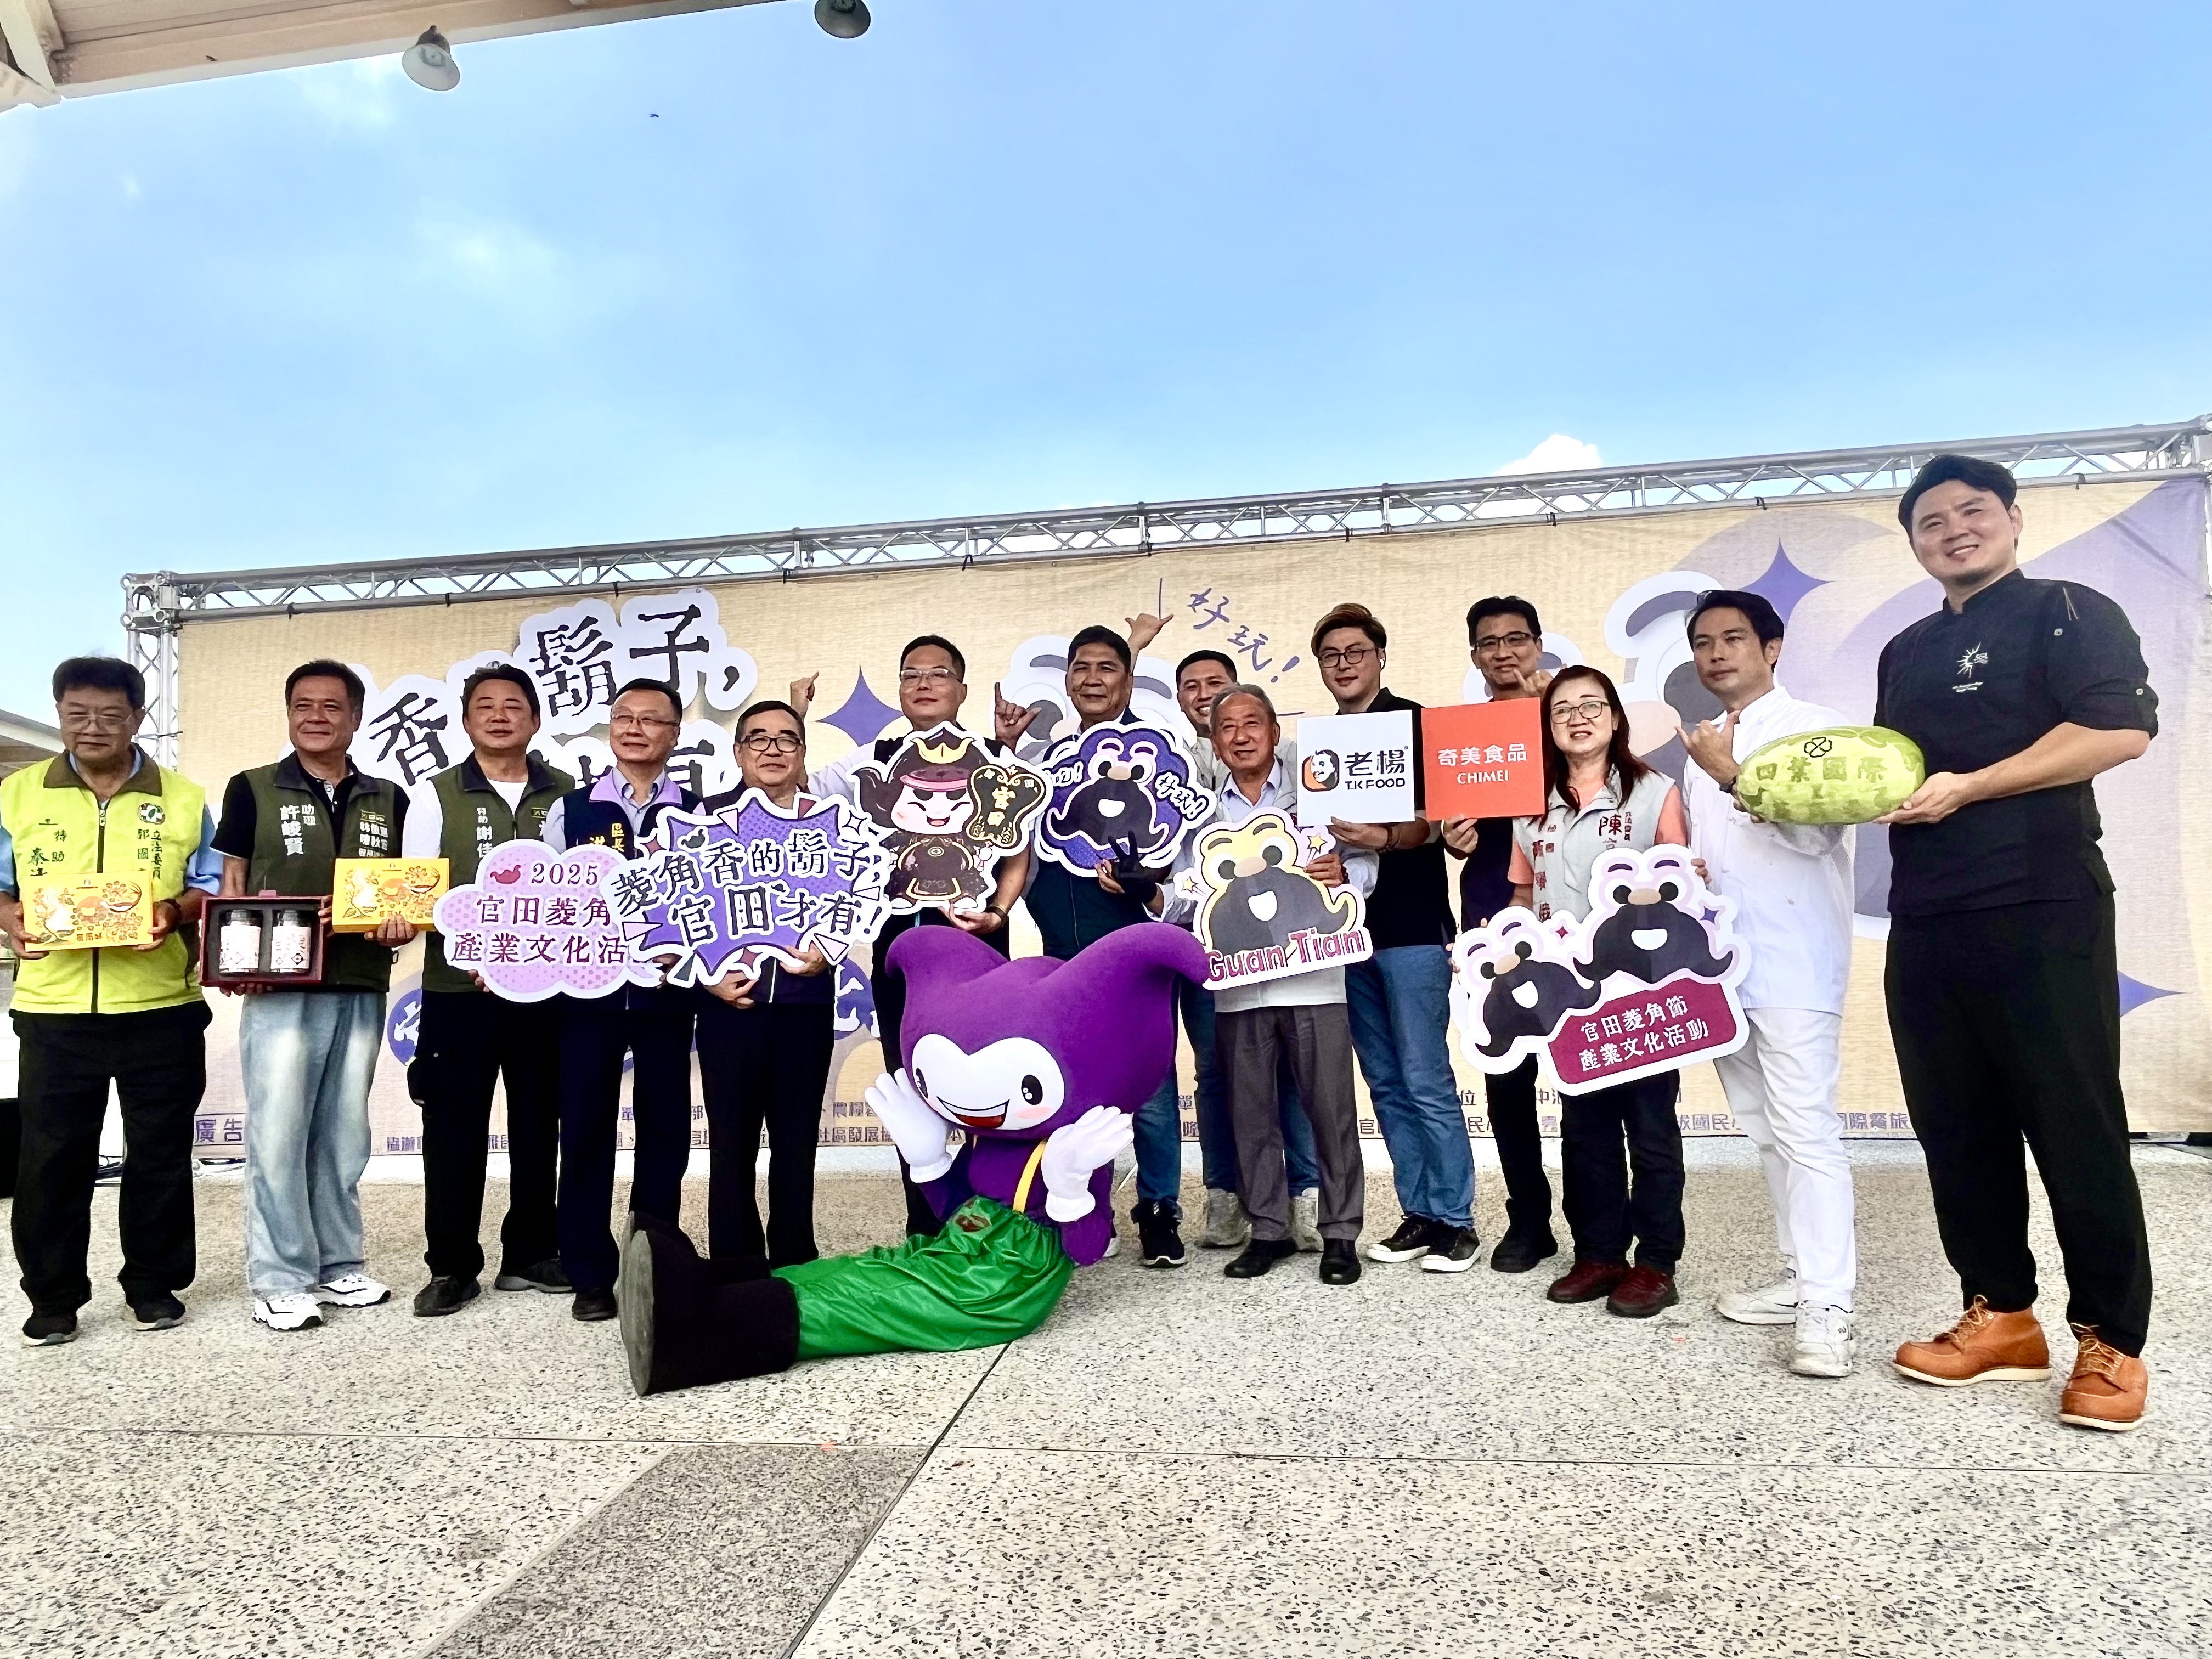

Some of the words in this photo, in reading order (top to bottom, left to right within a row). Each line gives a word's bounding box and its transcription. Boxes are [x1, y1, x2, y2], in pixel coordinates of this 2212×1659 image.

[368, 692, 448, 786] 香
[1345, 749, 1405, 776] 老楊
[1438, 743, 1527, 766] 奇美食品
[1457, 770, 1509, 785] CHIMEI
[531, 863, 599, 885] 2025
[1207, 945, 1289, 982] Guan
[1291, 928, 1366, 963] Tian
[1581, 995, 1688, 1043] 官田菱角節
[1579, 1018, 1708, 1072] 產業文化活動
[1537, 1088, 1561, 1105] 中
[195, 1118, 243, 1143] 廣告
[1678, 1114, 1743, 1130] 國民
